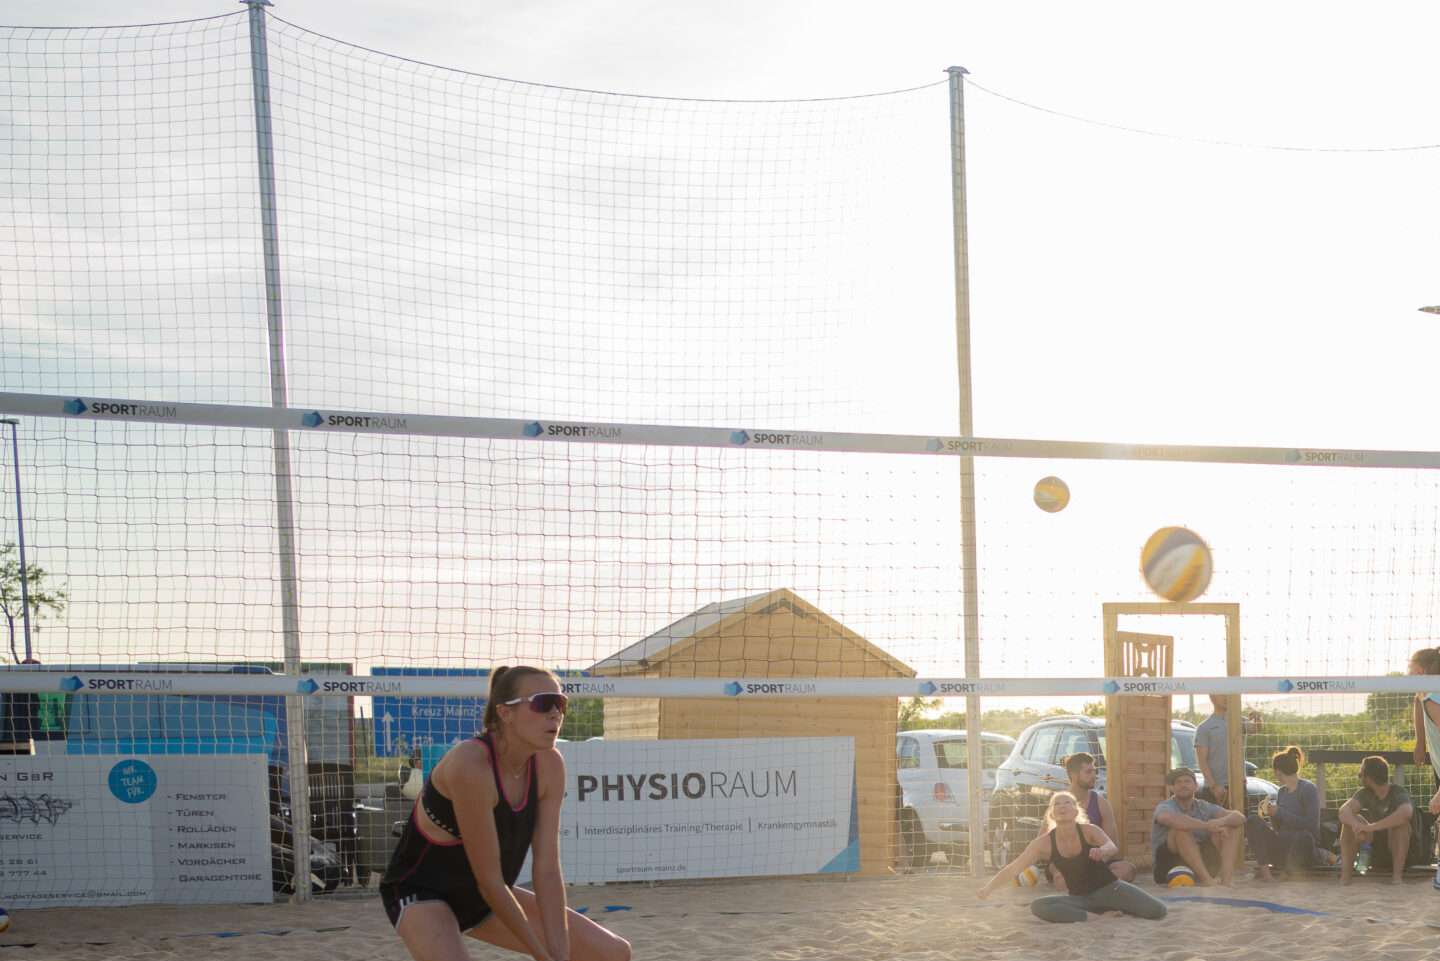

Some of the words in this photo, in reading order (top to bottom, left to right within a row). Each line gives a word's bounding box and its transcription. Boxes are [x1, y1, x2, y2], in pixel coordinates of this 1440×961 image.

[92, 402, 176, 418] SPORTRAUM
[328, 415, 406, 429] SPORTRAUM
[547, 424, 621, 439] SPORTRAUM
[753, 433, 823, 446] SPORTRAUM
[1305, 452, 1364, 463] SPORTRAUM
[88, 677, 173, 690] SPORTRAUM
[323, 681, 401, 693] SPORTRAUM
[747, 682, 816, 694] SPORTRAUM
[940, 682, 1006, 693] SPORTRAUM
[1123, 682, 1185, 693] SPORTRAUM
[1296, 681, 1355, 691] SPORTRAUM
[411, 705, 443, 717] Kreuz
[577, 770, 797, 802] PHYSIORAUM
[176, 808, 214, 816] TÜREN
[177, 824, 237, 832] ROLLÄDEN
[584, 825, 662, 837] Interdisziplinäres
[665, 822, 743, 835] Training/Therapie
[758, 820, 837, 832] Krankengymnastik
[177, 857, 246, 866] VORDÄCHER
